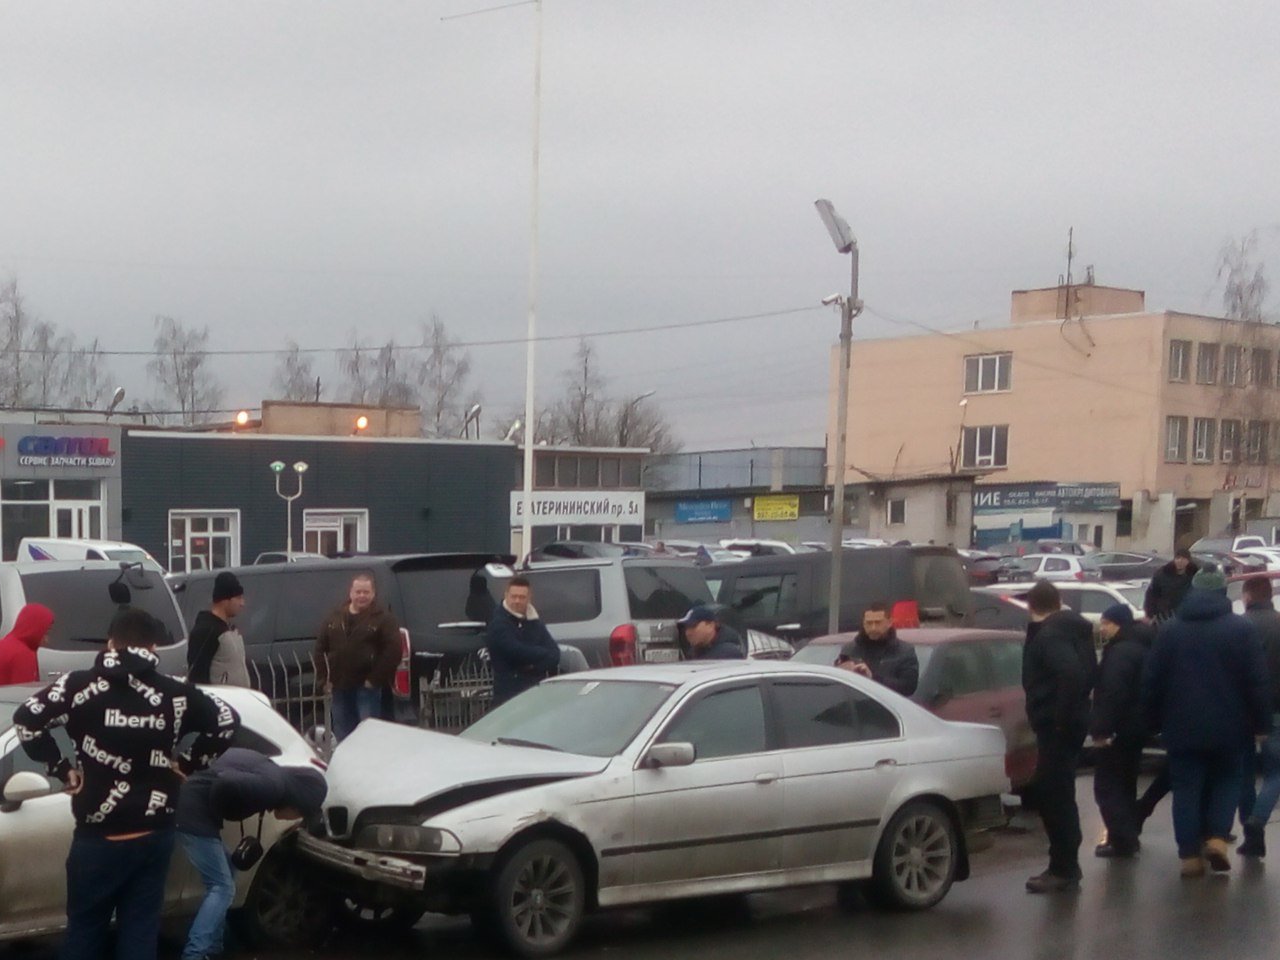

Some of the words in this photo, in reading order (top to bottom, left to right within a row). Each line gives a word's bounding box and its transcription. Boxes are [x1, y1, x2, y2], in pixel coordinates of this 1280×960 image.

[516, 499, 609, 516] ЕТЕРИНИНСКИЙ
[611, 504, 626, 517] пр.
[104, 708, 166, 731] liberté
[82, 734, 133, 775] liberté
